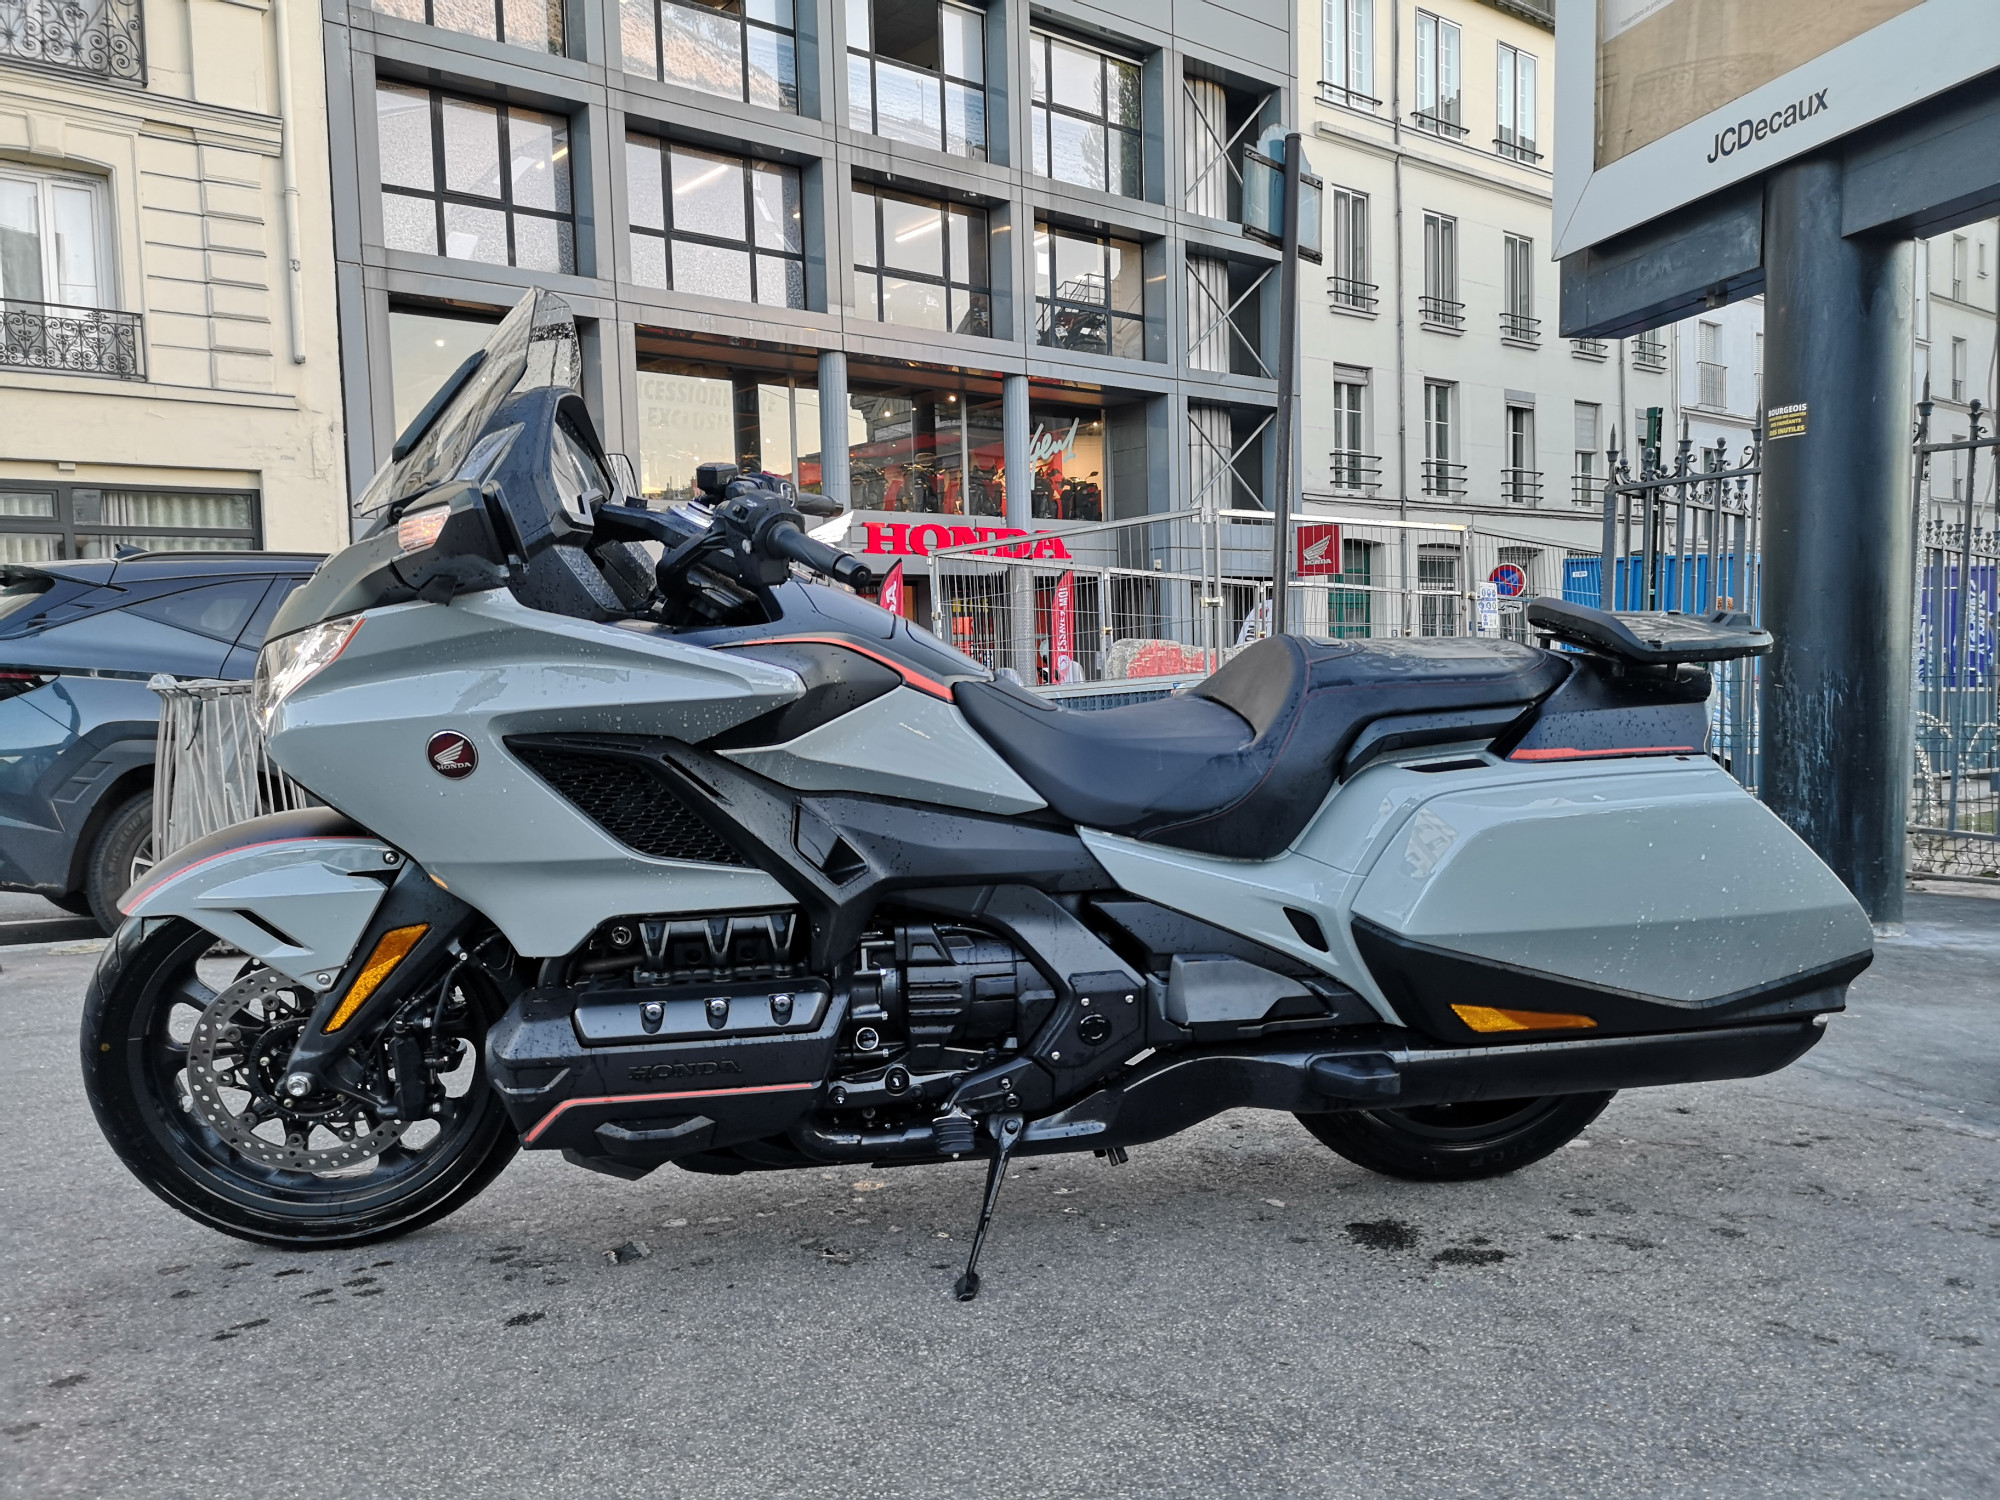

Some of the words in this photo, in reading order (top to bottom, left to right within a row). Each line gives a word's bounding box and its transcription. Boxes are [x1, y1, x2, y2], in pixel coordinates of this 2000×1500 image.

[1707, 88, 1828, 163] JCDecaux
[1768, 403, 1807, 417] BOURGEOIS
[1778, 425, 1805, 435] INUTILES
[862, 522, 1072, 559] HONDA
[437, 762, 472, 770] HONDA
[629, 1060, 742, 1079] HONDA
